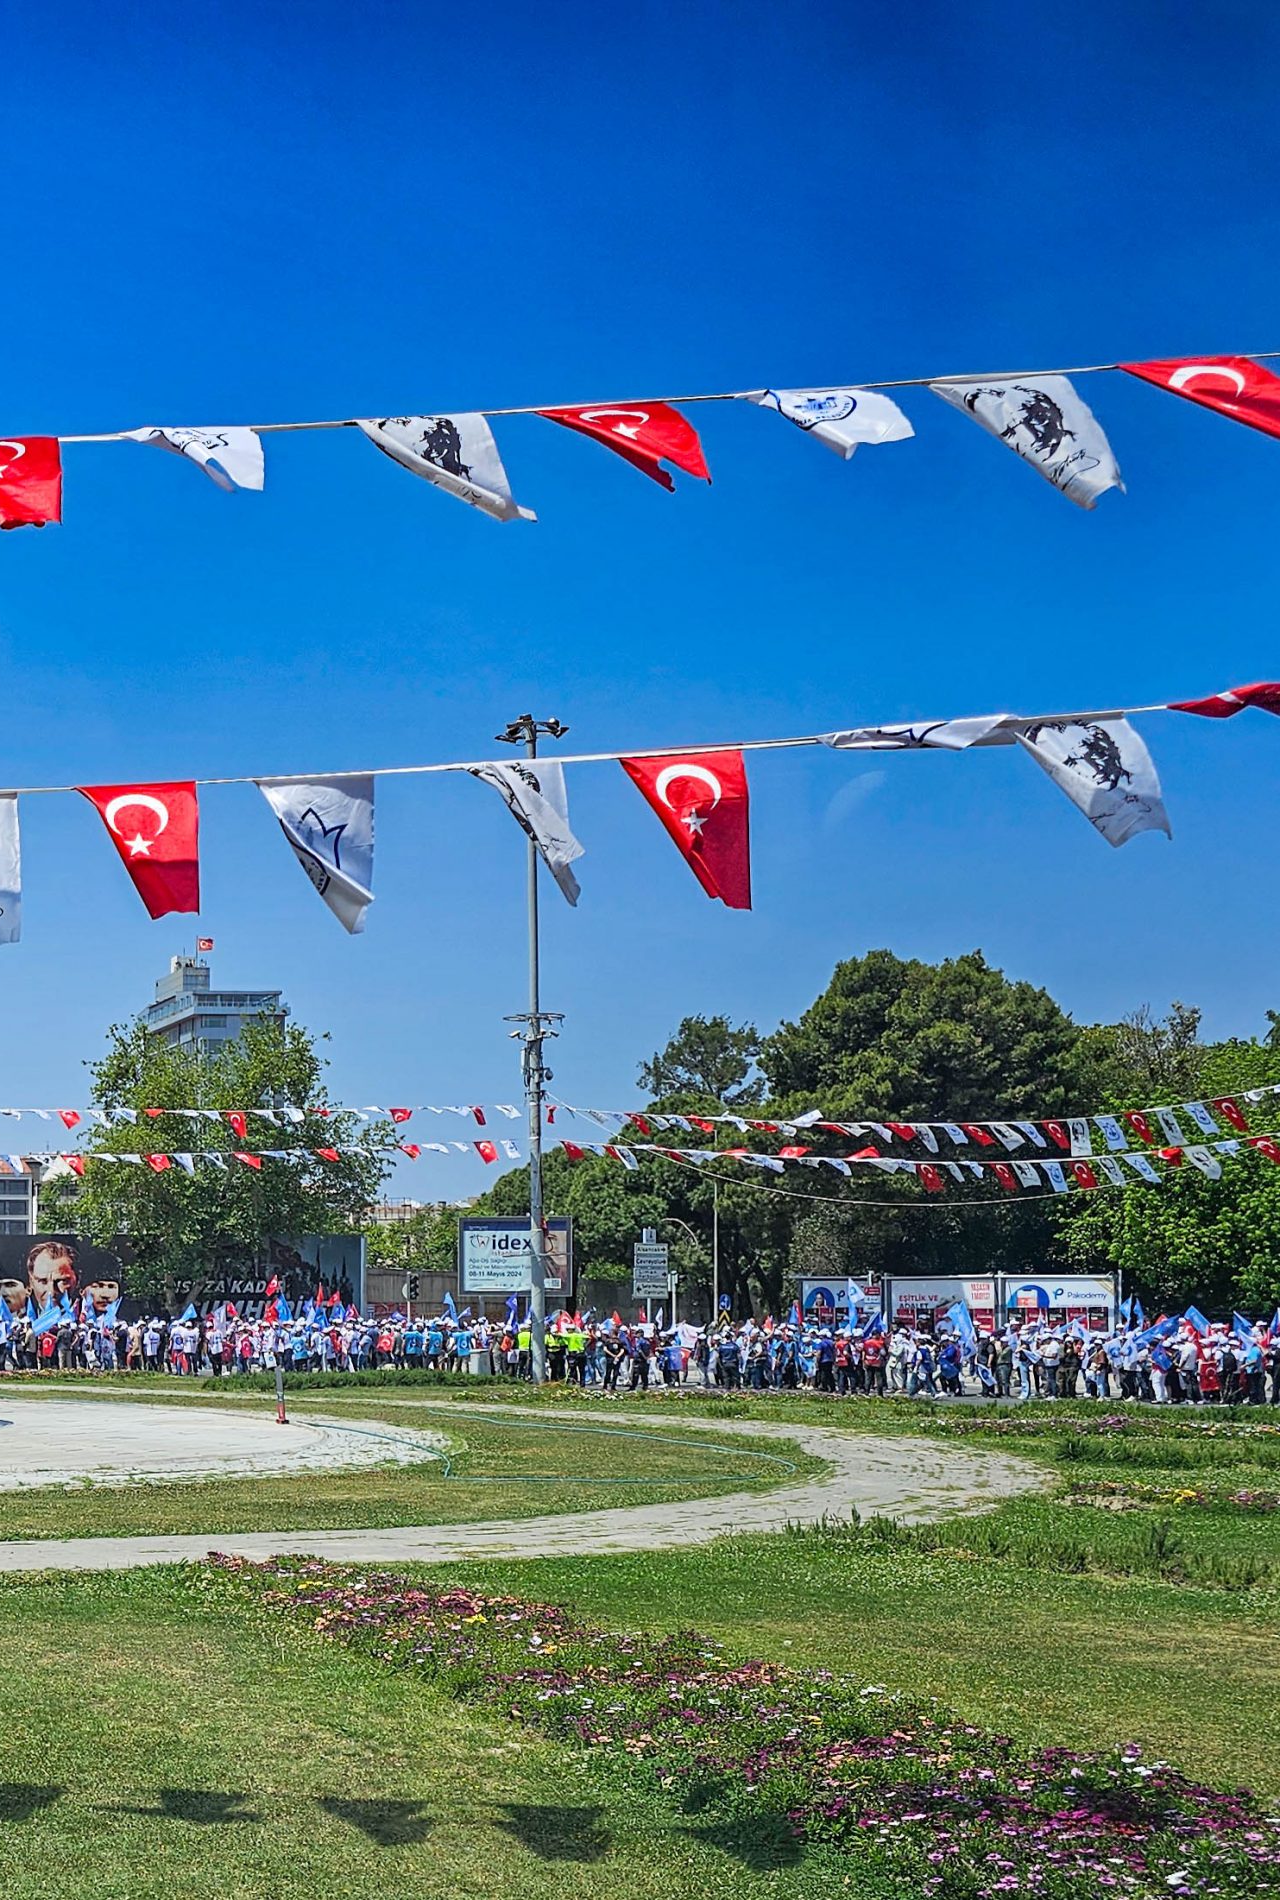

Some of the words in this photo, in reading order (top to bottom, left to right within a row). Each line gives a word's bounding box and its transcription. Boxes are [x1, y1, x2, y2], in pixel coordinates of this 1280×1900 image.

[492, 1234, 532, 1250] idex
[231, 1279, 287, 1294] KADR
[899, 1294, 927, 1303] EŞİTLİK
[928, 1294, 939, 1302] VE
[1067, 1291, 1108, 1300] Pakodemy
[899, 1302, 929, 1310] ADALET
